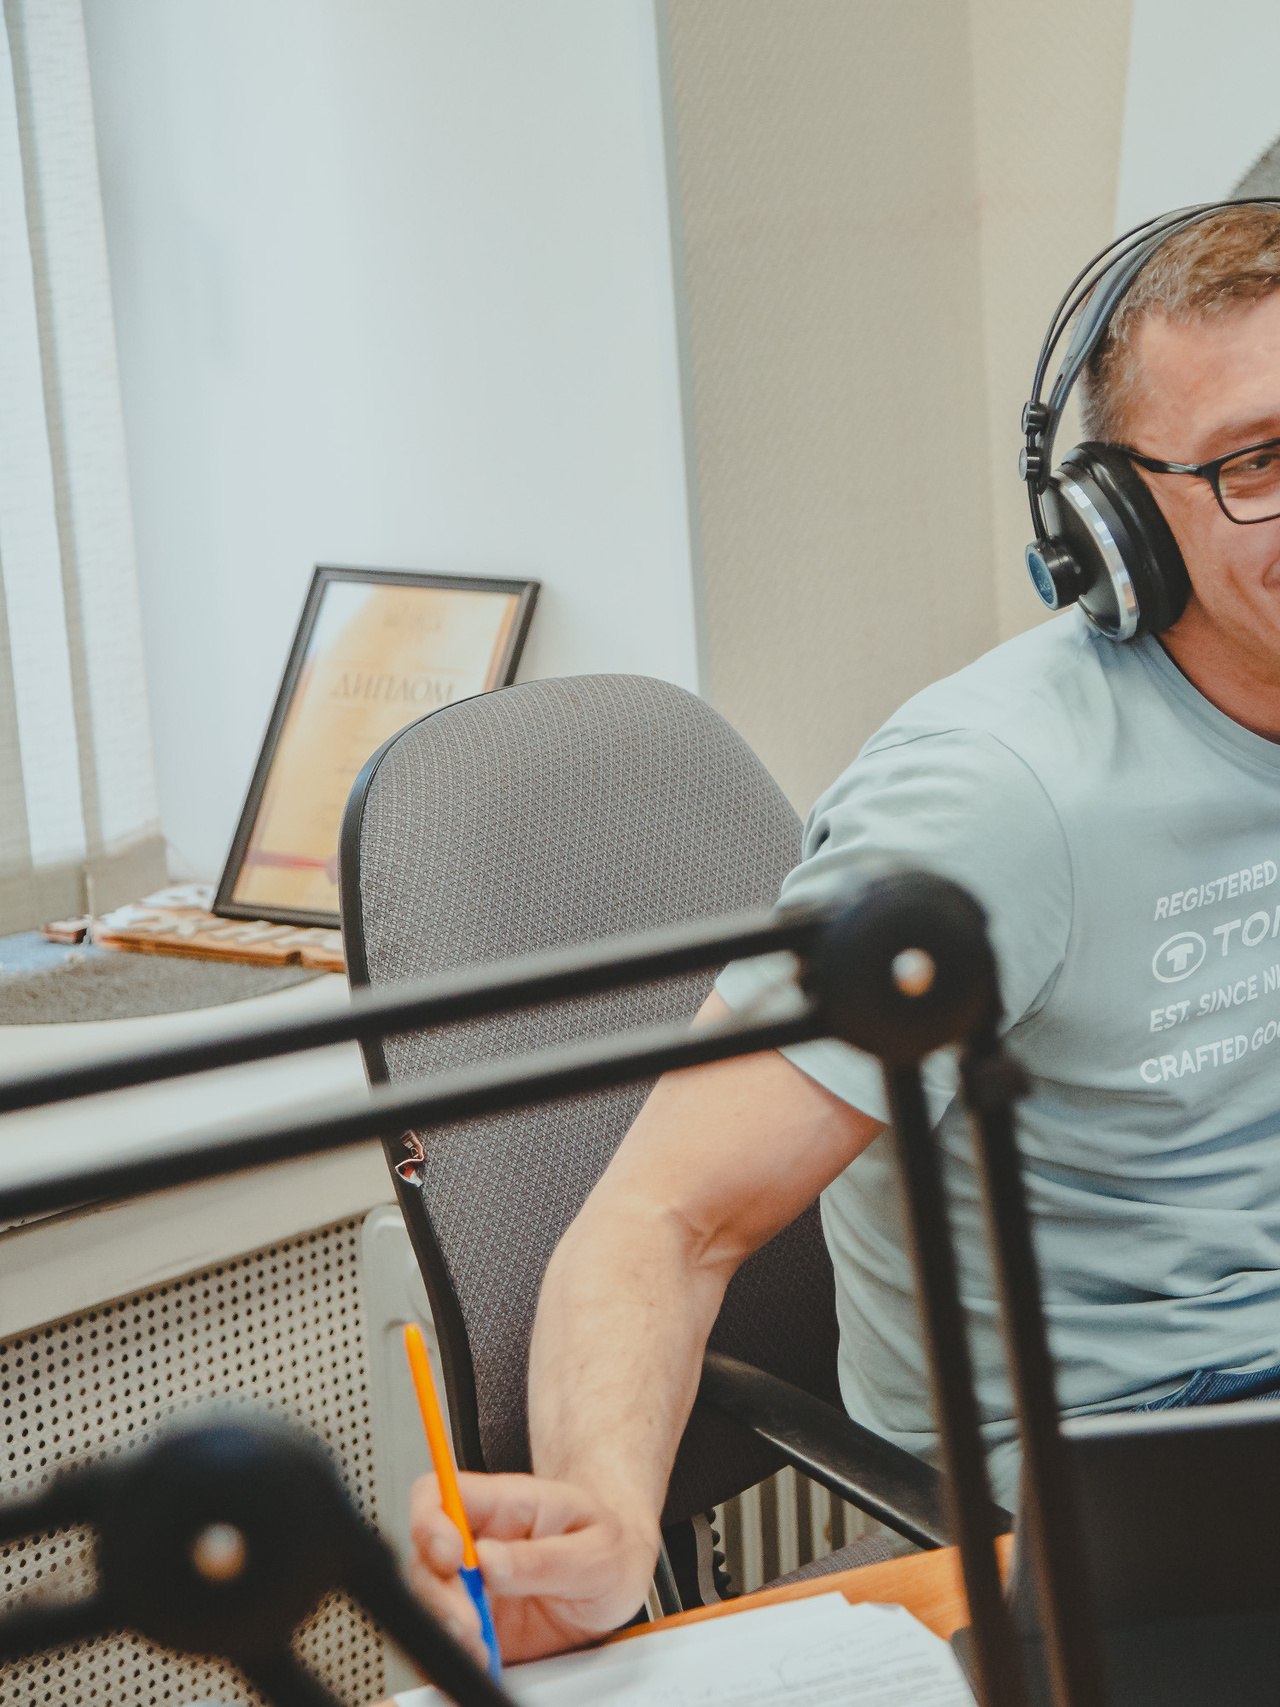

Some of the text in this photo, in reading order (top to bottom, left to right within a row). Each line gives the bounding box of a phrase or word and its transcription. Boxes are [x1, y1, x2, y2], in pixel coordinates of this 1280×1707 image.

[1154, 859, 1278, 921] REGISTERED
[1197, 975, 1258, 1016] SINCE
[1140, 1034, 1248, 1084] CRAFTED
